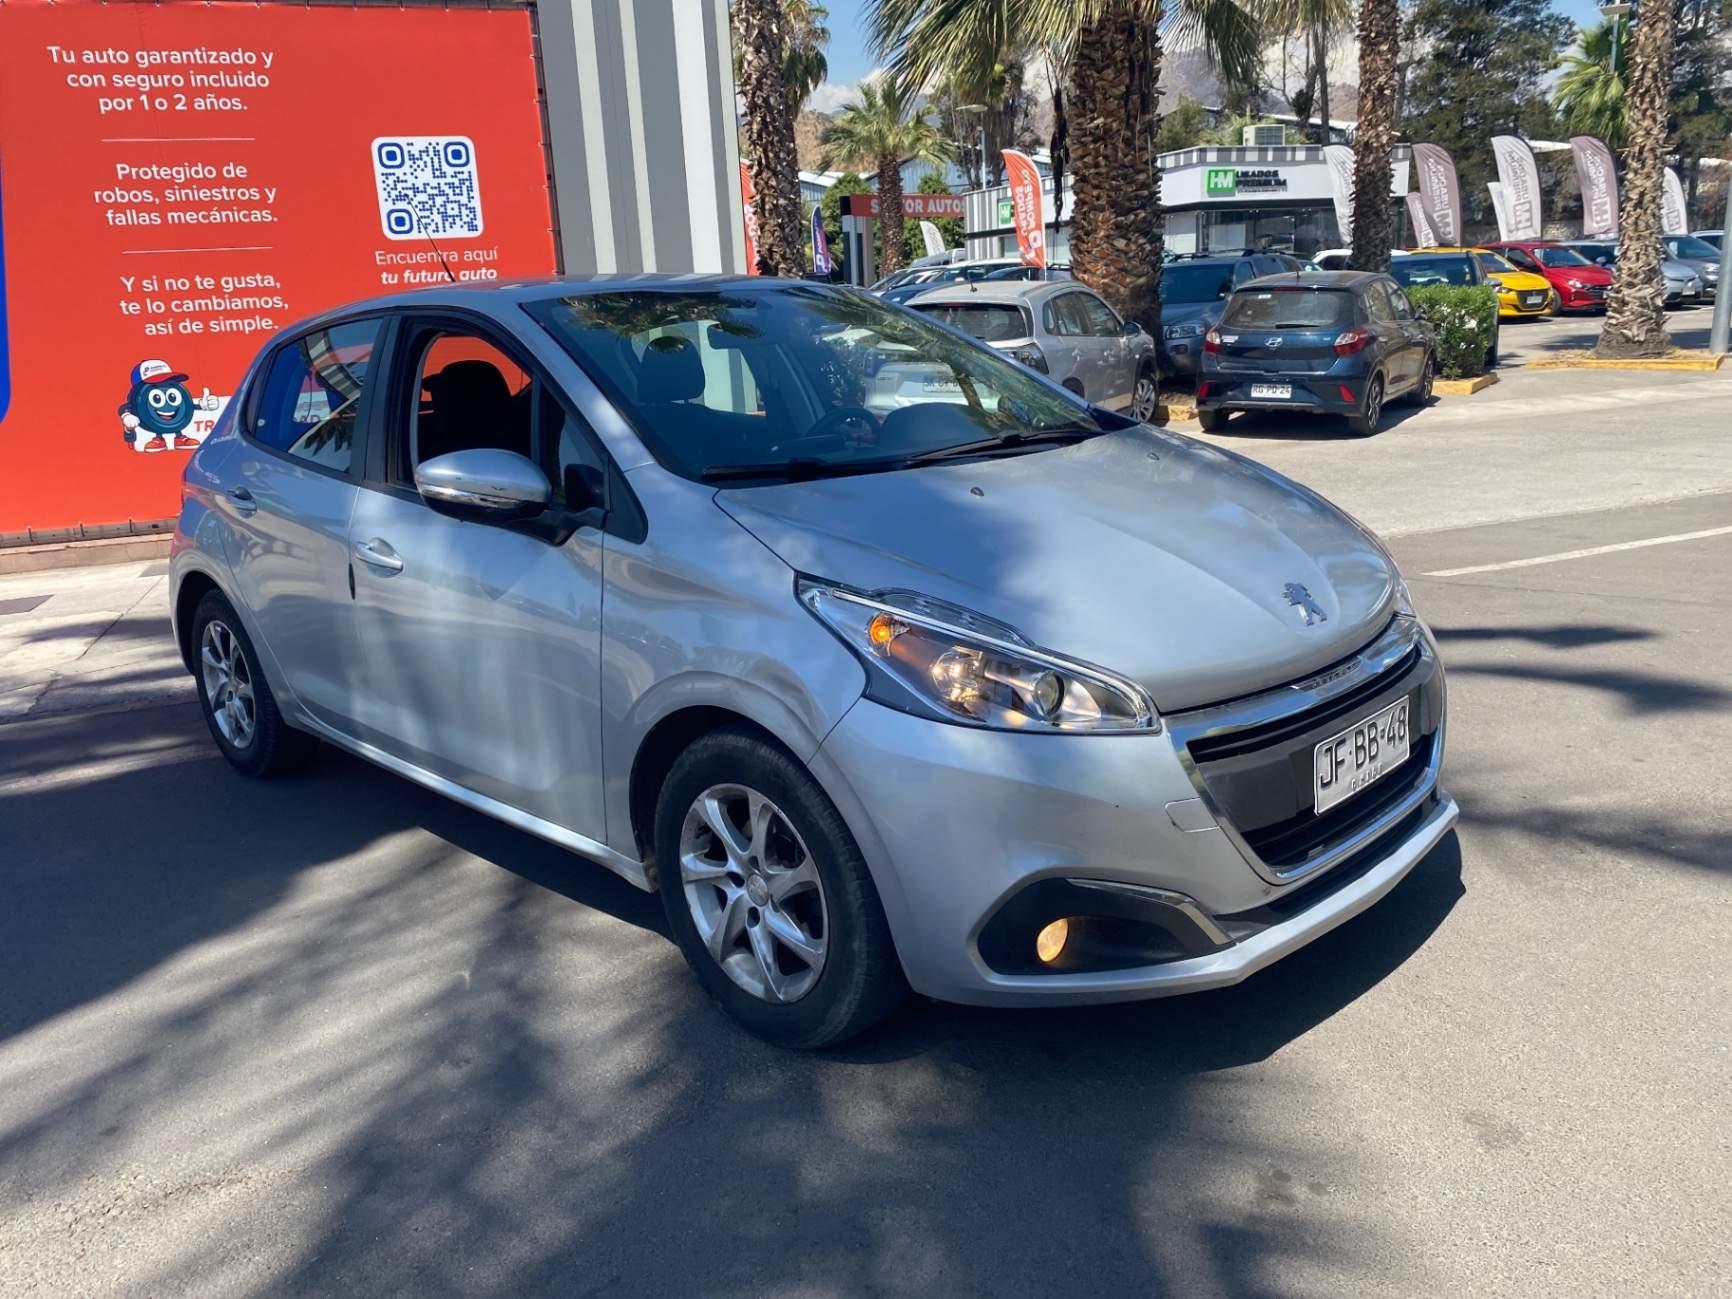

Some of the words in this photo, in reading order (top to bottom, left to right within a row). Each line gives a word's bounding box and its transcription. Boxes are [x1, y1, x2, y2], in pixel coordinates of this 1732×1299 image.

[47, 46, 75, 63] Tu
[83, 48, 129, 63] auto
[136, 47, 256, 68] garantizado
[262, 52, 273, 68] y
[67, 74, 106, 87] con
[112, 75, 184, 91] seguro
[190, 71, 269, 87] incluido
[99, 98, 133, 114] por
[139, 94, 149, 110] 1
[155, 98, 167, 110] o
[173, 94, 187, 110] 2
[194, 94, 247, 110] años.
[116, 163, 216, 183] Protegido
[223, 162, 247, 178] de
[1209, 171, 1234, 188] HM
[95, 187, 159, 204] robos,
[165, 185, 260, 201] siniestros
[265, 188, 276, 203] y
[871, 198, 923, 213] SOR
[106, 209, 161, 225] fallas
[168, 207, 277, 223] mecánicas.
[376, 250, 458, 264] Encuentra
[464, 247, 497, 263] aquí
[121, 277, 134, 292] Y
[142, 276, 158, 291] si
[165, 279, 190, 290] no
[195, 275, 214, 289] te
[221, 274, 280, 292] gusta,
[381, 272, 398, 284] tu
[403, 270, 455, 283] futuro
[459, 266, 497, 280] auto
[120, 301, 140, 314] te
[146, 298, 165, 313] lo
[171, 295, 288, 312] cambiamos,
[145, 319, 172, 335] así
[179, 319, 203, 333] de
[210, 315, 278, 334] simple.
